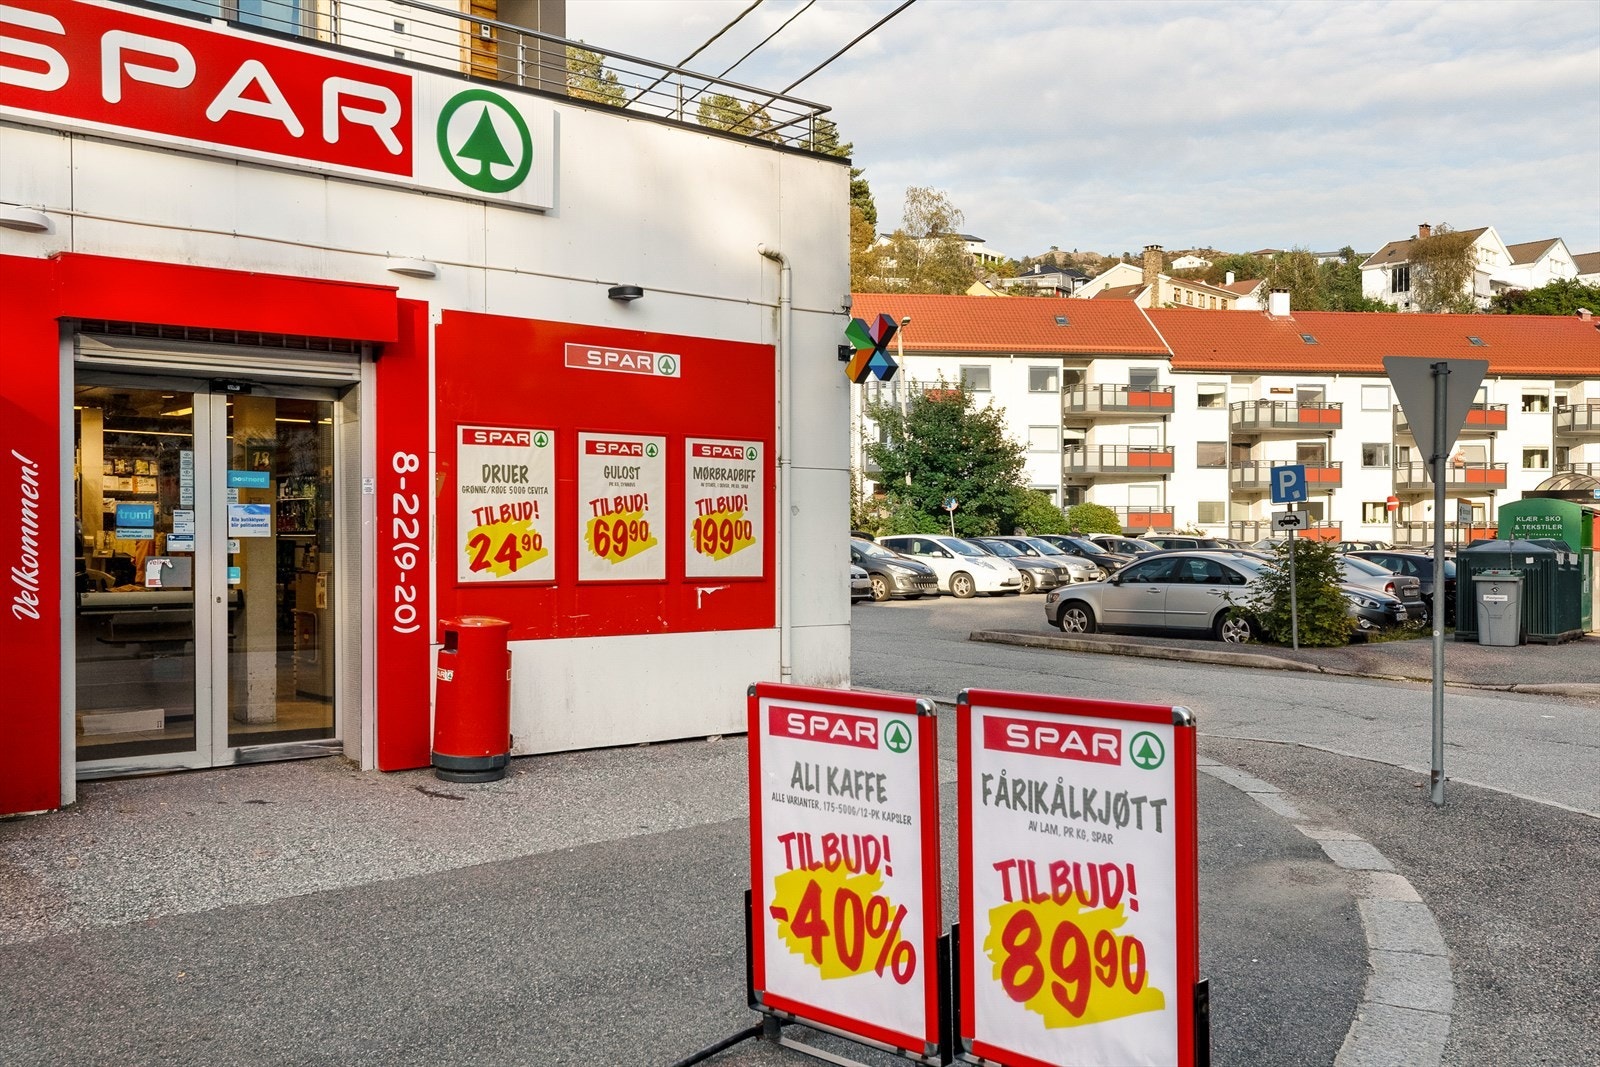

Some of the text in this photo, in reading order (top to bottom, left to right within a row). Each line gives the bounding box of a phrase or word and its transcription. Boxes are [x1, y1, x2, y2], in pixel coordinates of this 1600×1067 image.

[0, 4, 403, 156] SPAR
[587, 350, 652, 371] SPAR
[474, 431, 530, 445] SPAR
[595, 442, 643, 456] SPAR
[701, 444, 743, 459] SPAR
[232, 475, 265, 484] postnord
[481, 463, 529, 484] DRUER
[603, 465, 641, 480] GULOST
[692, 466, 756, 483] MØRBRADBIFF
[461, 485, 549, 495] GRØNNE/RØDE 500G CEVITA
[117, 509, 153, 520] trumf
[471, 500, 540, 527] TILBUD!
[588, 492, 649, 517] TILBUD!
[694, 493, 749, 517] TILBUD!
[11, 449, 41, 620] Velkommen!
[787, 712, 876, 745] SPAR
[1006, 723, 1119, 760] SPAR
[790, 760, 888, 805] ALI KAFFE
[771, 791, 786, 803] ALLE
[786, 794, 822, 811] VARIANTER,
[881, 811, 912, 826] KAPSLER
[981, 768, 1168, 834] FÅRIKÅLKJØTT
[1028, 820, 1114, 845] AV LAM, PR KG, SPAR
[777, 831, 893, 878] TILBUD!
[993, 858, 1139, 913] TILBUD!
[769, 878, 917, 985] -40%
